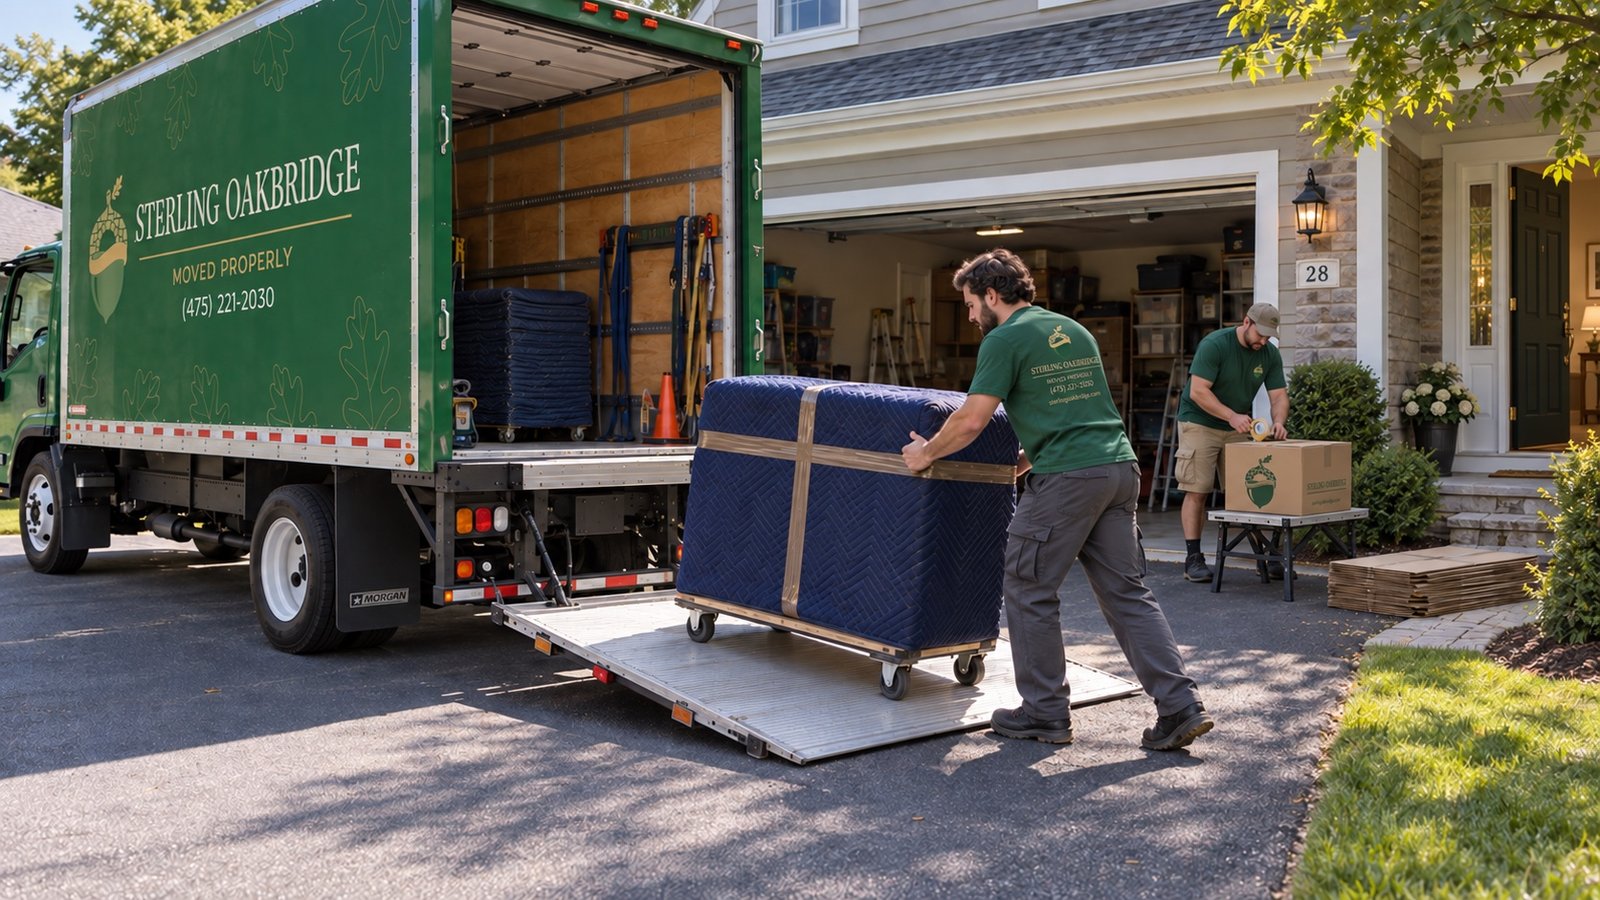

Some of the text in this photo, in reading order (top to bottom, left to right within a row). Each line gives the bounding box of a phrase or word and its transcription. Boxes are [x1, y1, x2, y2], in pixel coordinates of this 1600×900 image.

[134, 143, 361, 243] STERLING OAKBRIDGE
[172, 246, 293, 286] MOVED PROPERLY
[1306, 265, 1328, 282] 28
[182, 286, 275, 322] (475) 221-2030
[364, 591, 407, 603] MORGAN
